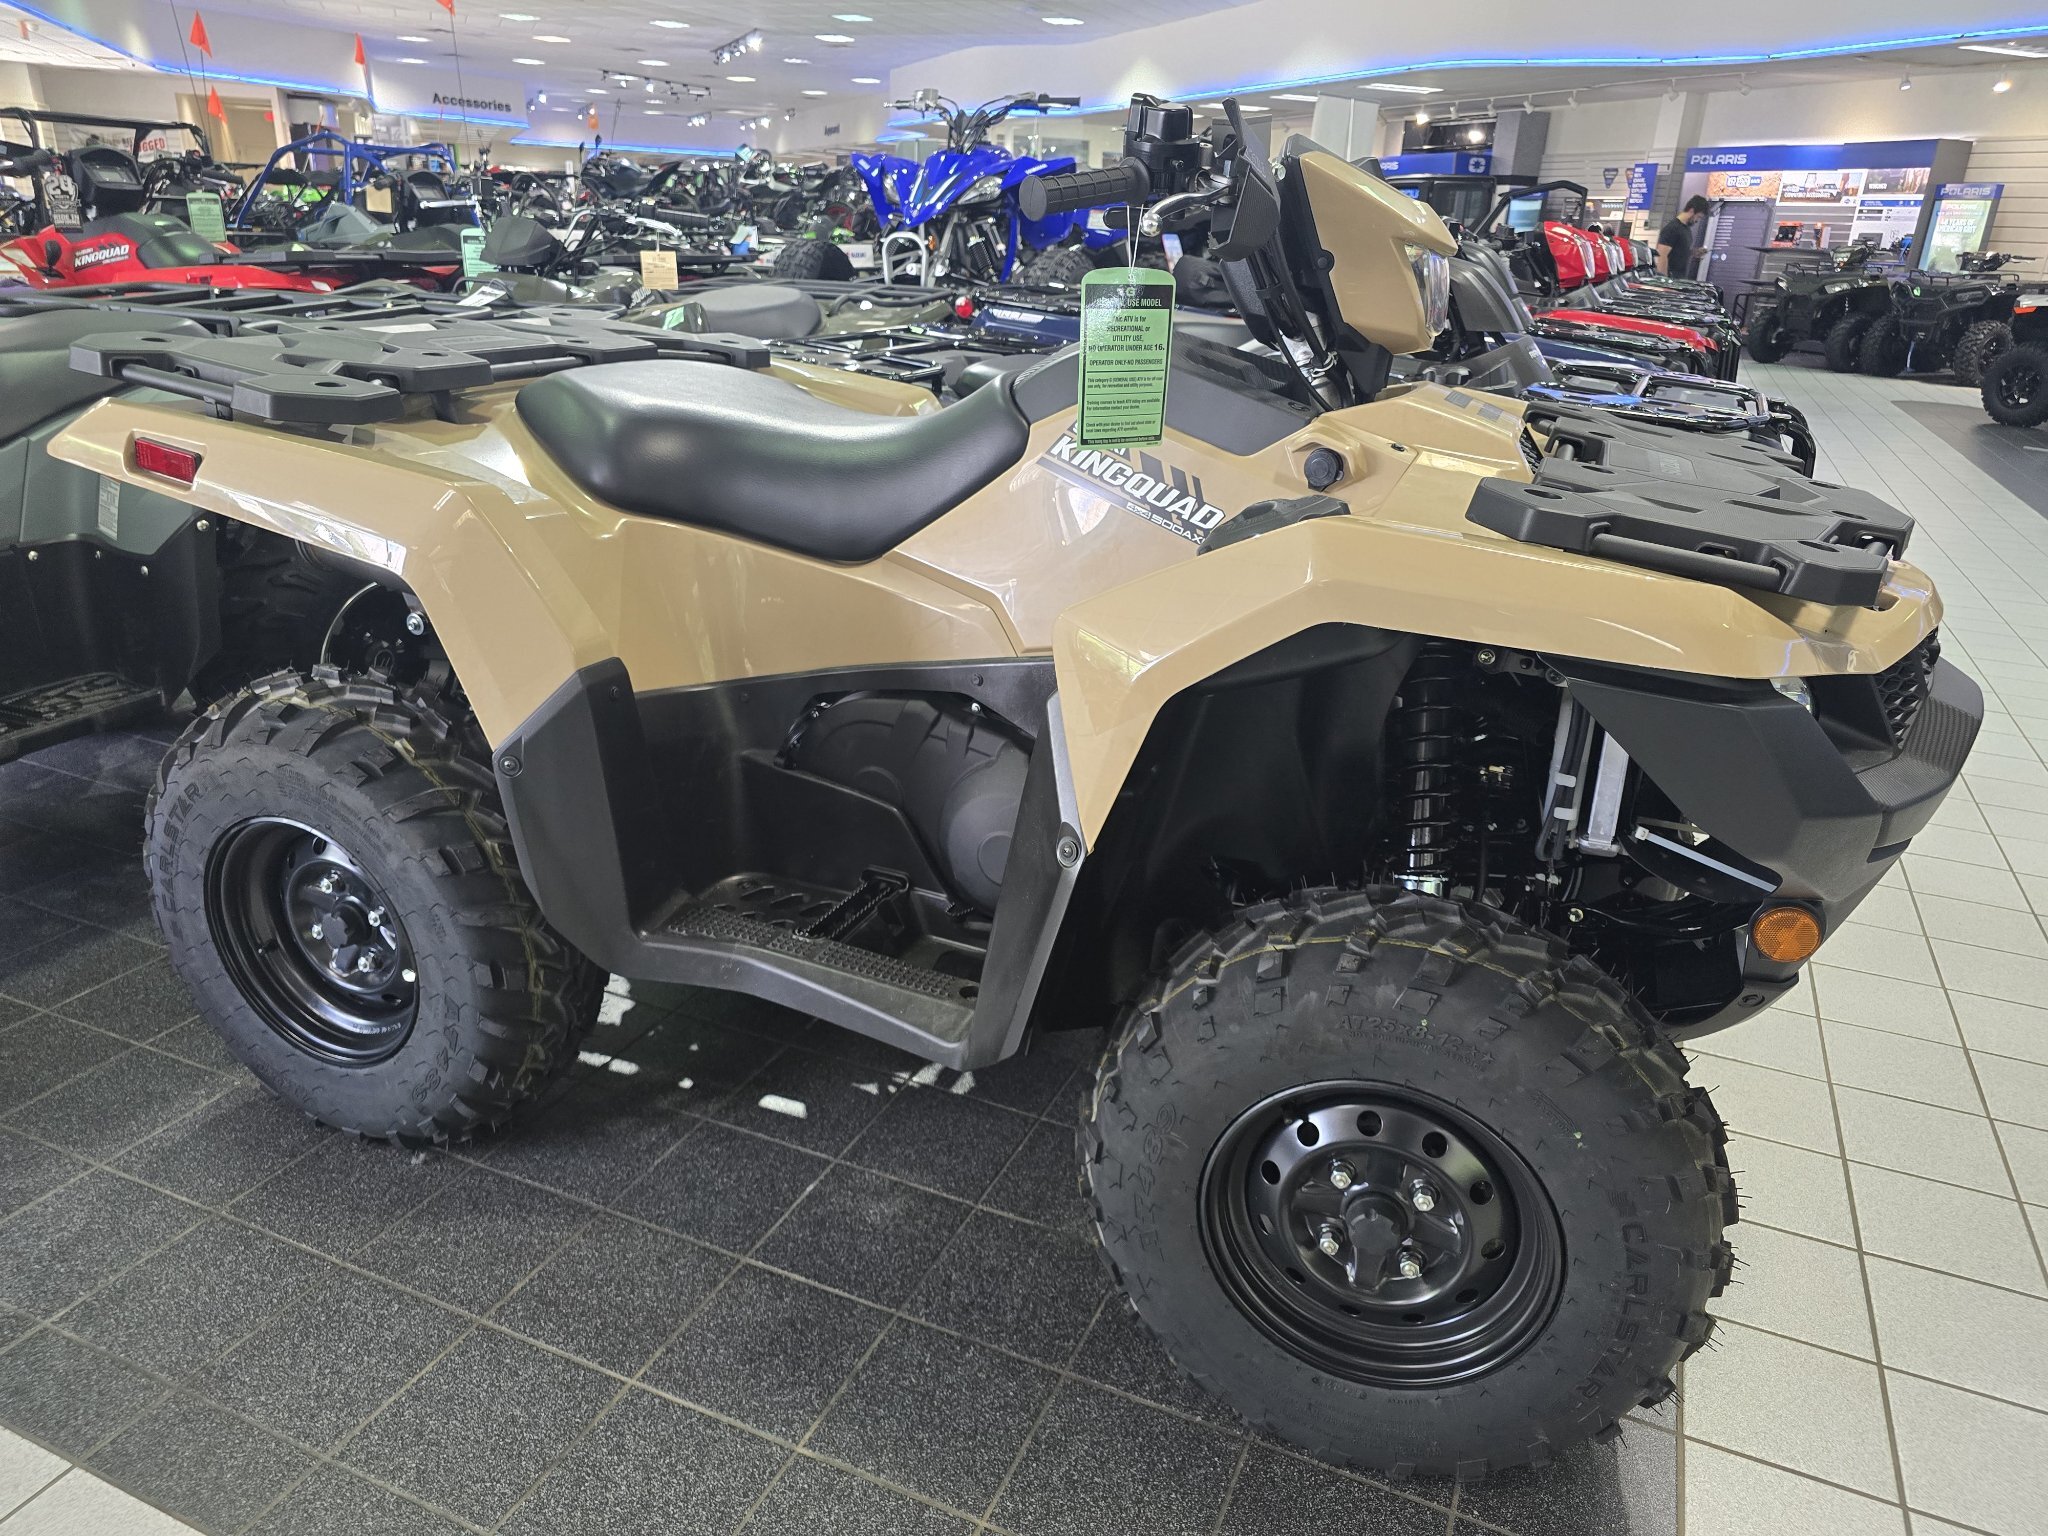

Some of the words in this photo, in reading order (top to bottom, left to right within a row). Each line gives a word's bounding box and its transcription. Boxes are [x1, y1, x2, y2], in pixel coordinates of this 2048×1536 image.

[433, 93, 511, 112] Accessories
[1691, 154, 1747, 165] POLARIS
[1940, 187, 1991, 196] POLARIS
[74, 245, 129, 267] KINGQUAD
[1127, 298, 1139, 307] USE
[1141, 298, 1162, 307] MODEL
[1050, 436, 1226, 531] KINGQUAD
[1126, 502, 1152, 521] 4x4
[158, 782, 204, 914] CARLSTAR
[1581, 1222, 1650, 1399] CARLSTAR
